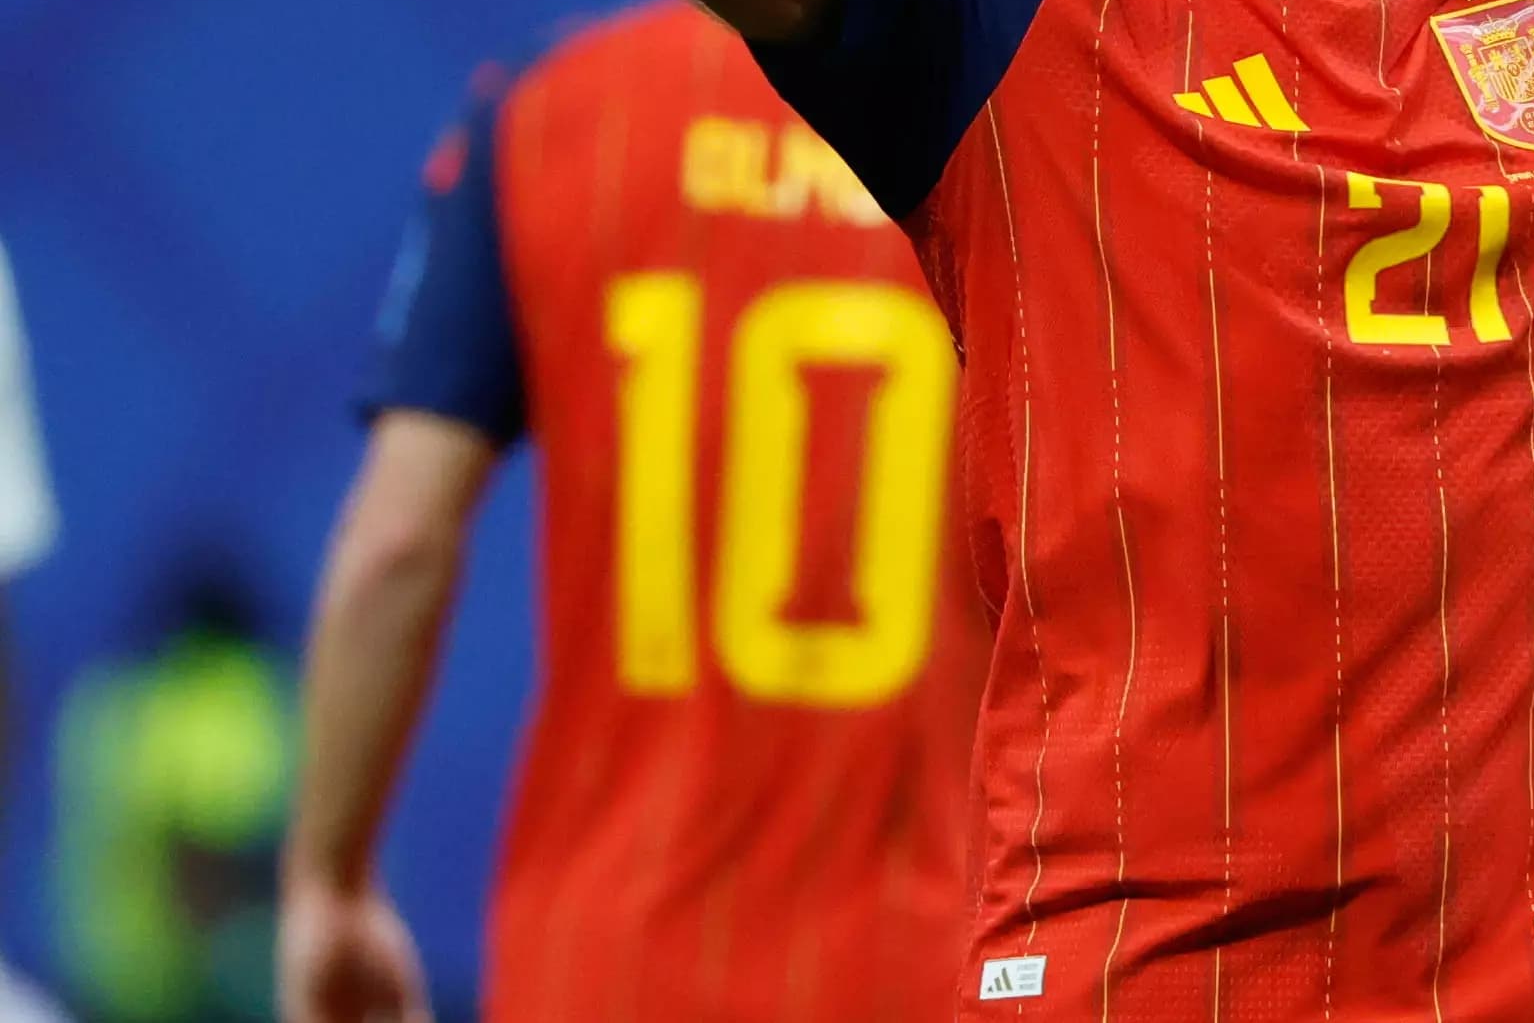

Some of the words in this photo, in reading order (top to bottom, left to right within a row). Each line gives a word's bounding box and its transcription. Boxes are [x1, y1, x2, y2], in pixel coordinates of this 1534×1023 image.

[682, 115, 892, 228] OLM
[1344, 171, 1513, 346] 21
[606, 271, 957, 707] 10
